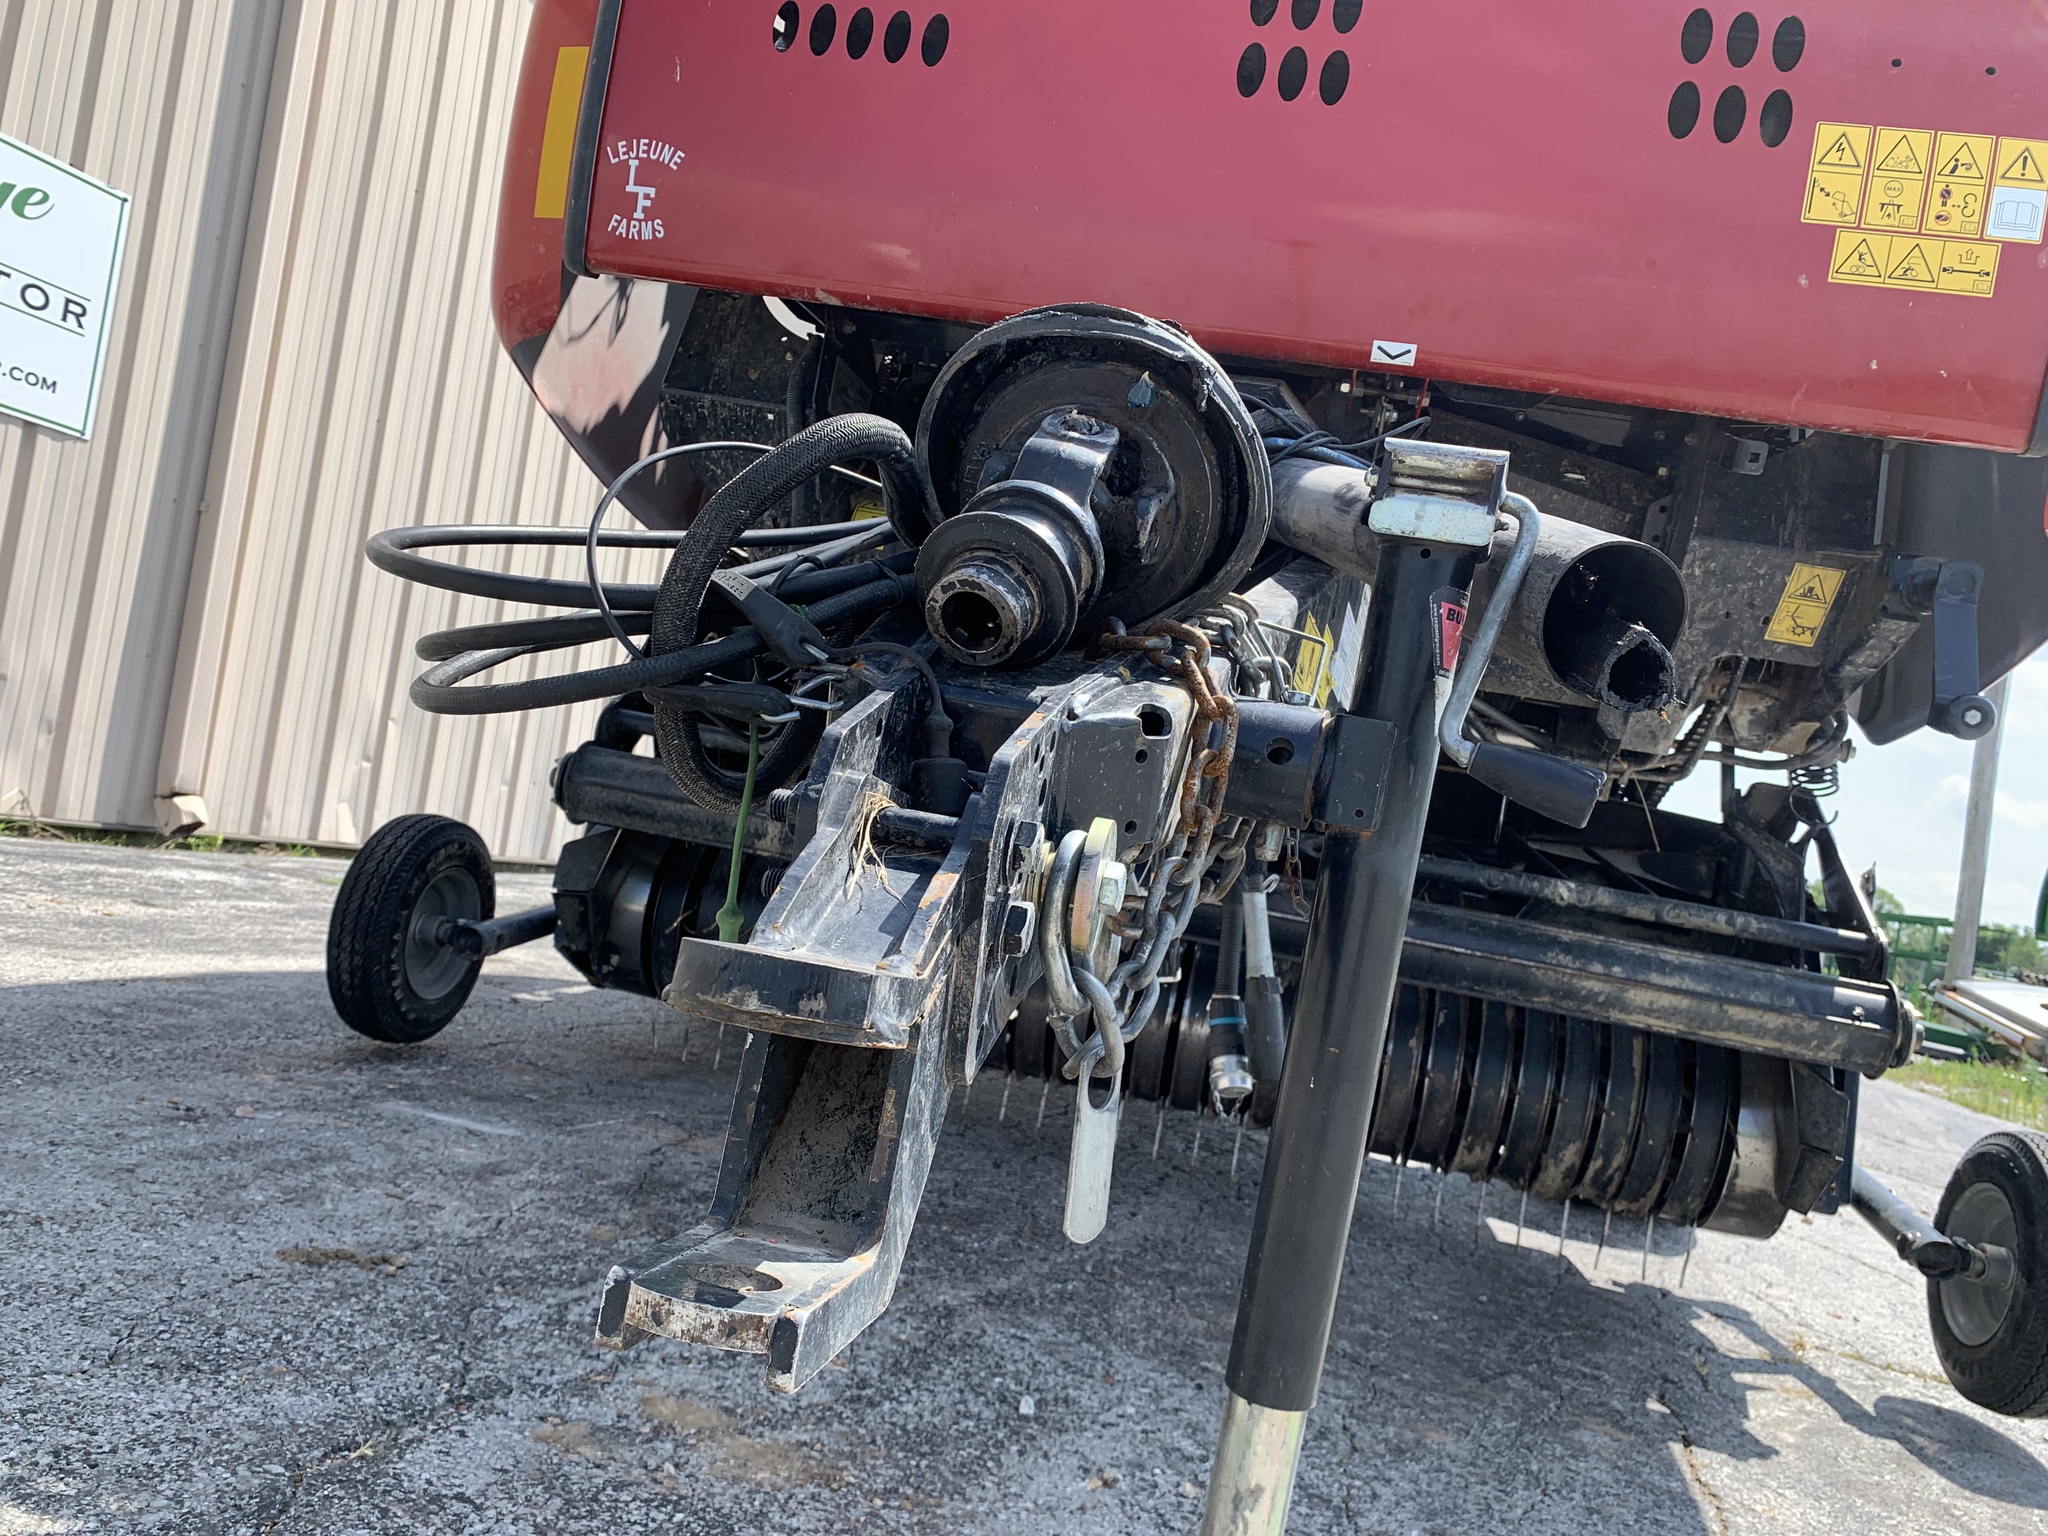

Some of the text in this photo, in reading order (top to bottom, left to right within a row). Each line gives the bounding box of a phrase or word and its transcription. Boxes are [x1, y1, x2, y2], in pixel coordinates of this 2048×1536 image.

[607, 139, 685, 170] LEJEUNE
[607, 213, 665, 240] FARMS
[0, 361, 57, 394] .COM
